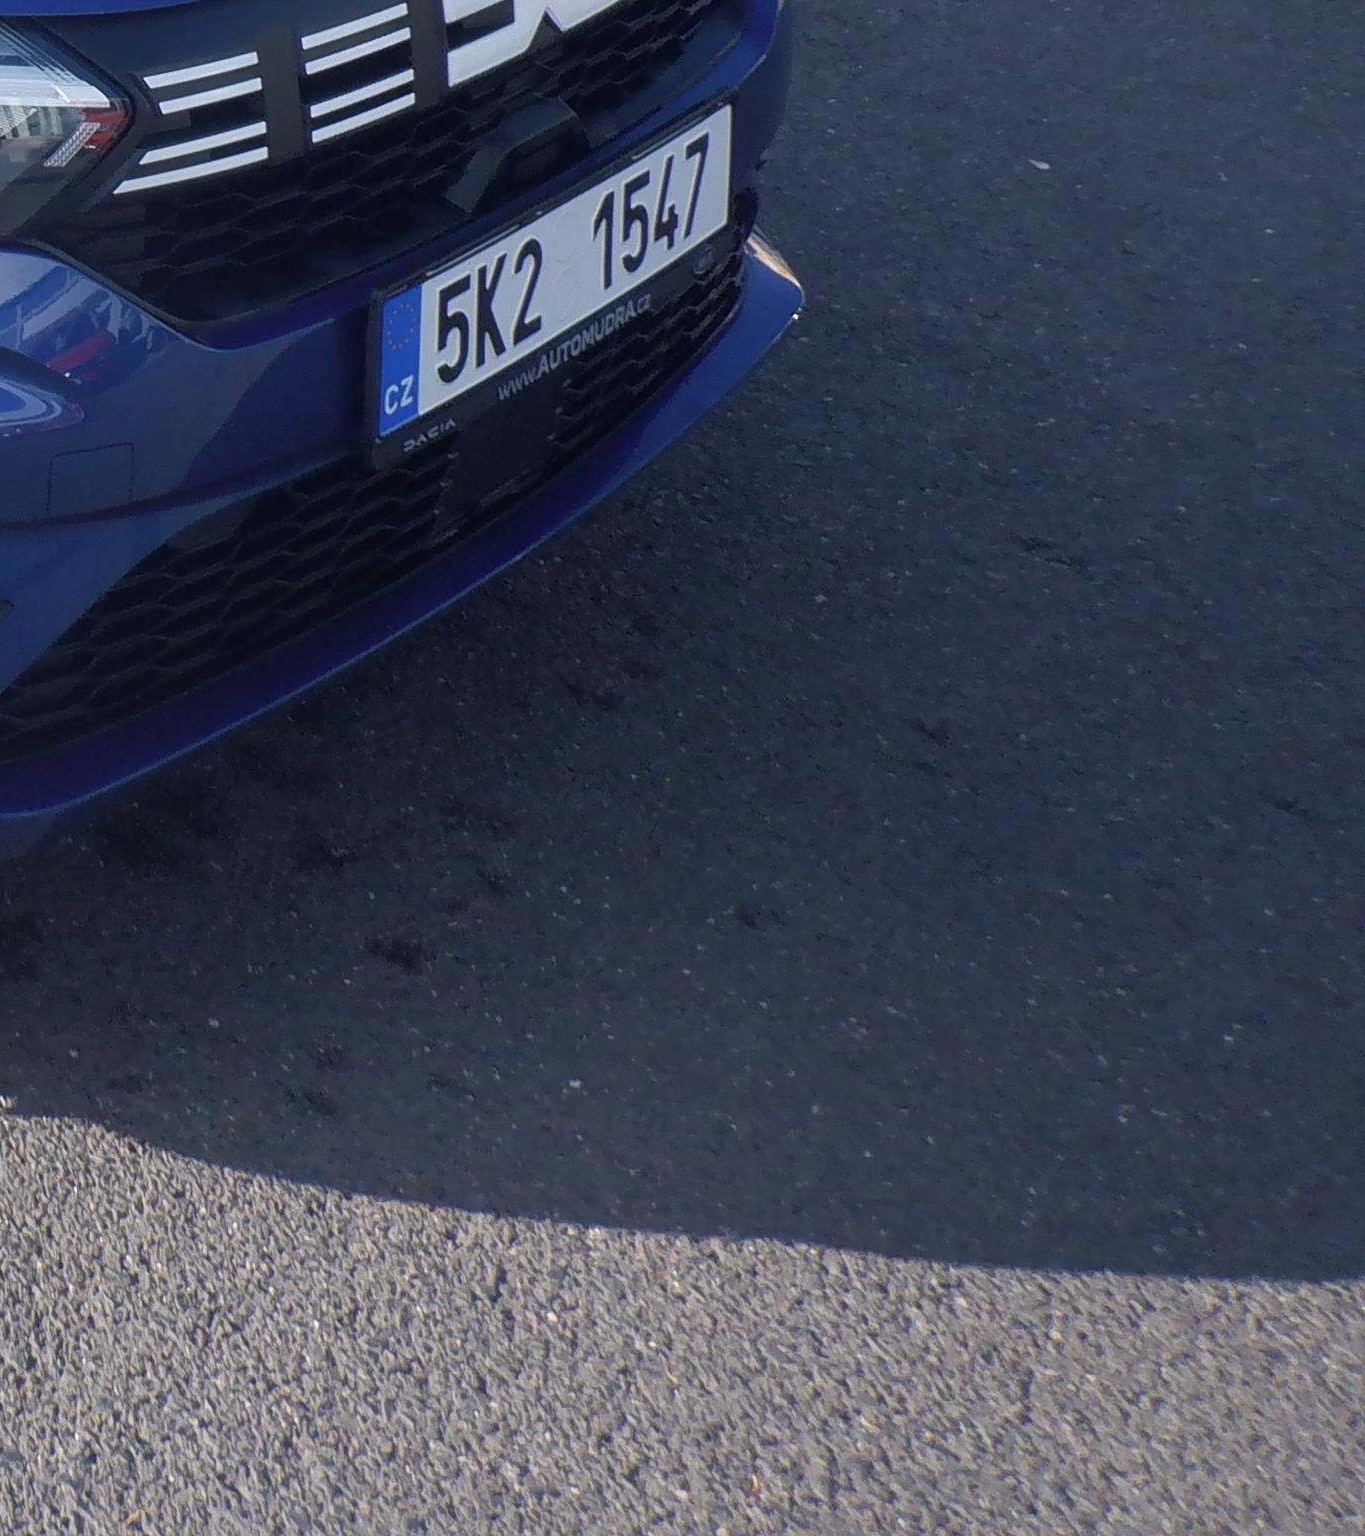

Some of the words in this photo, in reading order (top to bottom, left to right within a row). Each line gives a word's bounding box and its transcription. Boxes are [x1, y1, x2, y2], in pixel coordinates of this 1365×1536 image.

[436, 237, 543, 383] 5K2
[591, 131, 710, 291] 1547
[384, 374, 415, 416] CZ
[403, 417, 457, 453] DACIA
